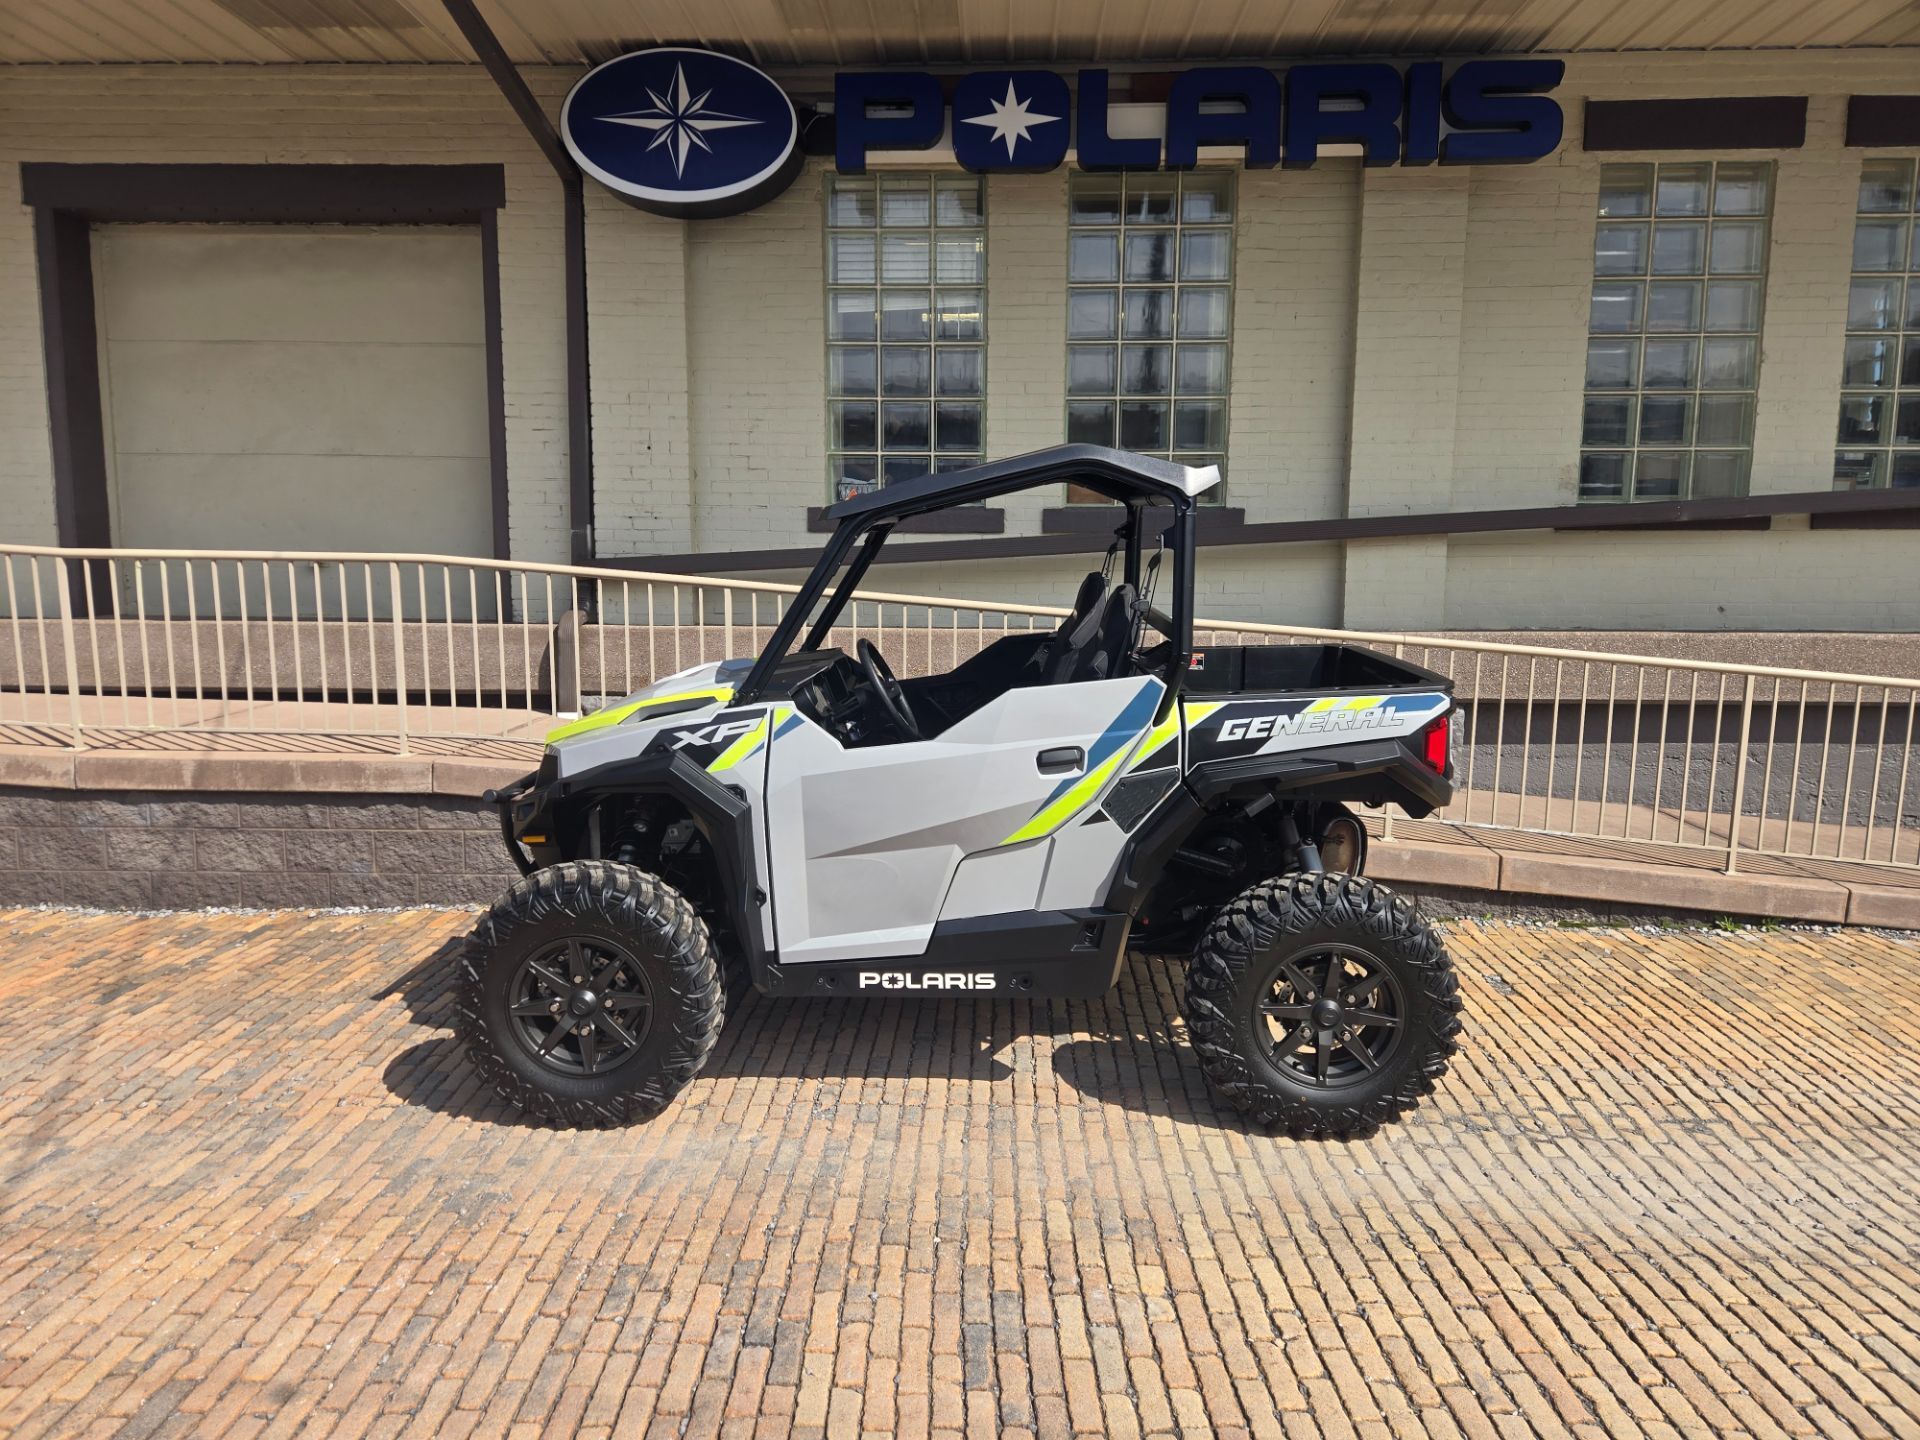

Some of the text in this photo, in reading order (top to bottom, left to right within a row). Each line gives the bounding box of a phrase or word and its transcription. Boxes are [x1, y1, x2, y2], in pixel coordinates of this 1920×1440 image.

[835, 60, 1564, 173] POLARIS
[673, 717, 762, 749] XP
[1216, 706, 1405, 742] GENERAL
[859, 972, 996, 990] POLARIS
